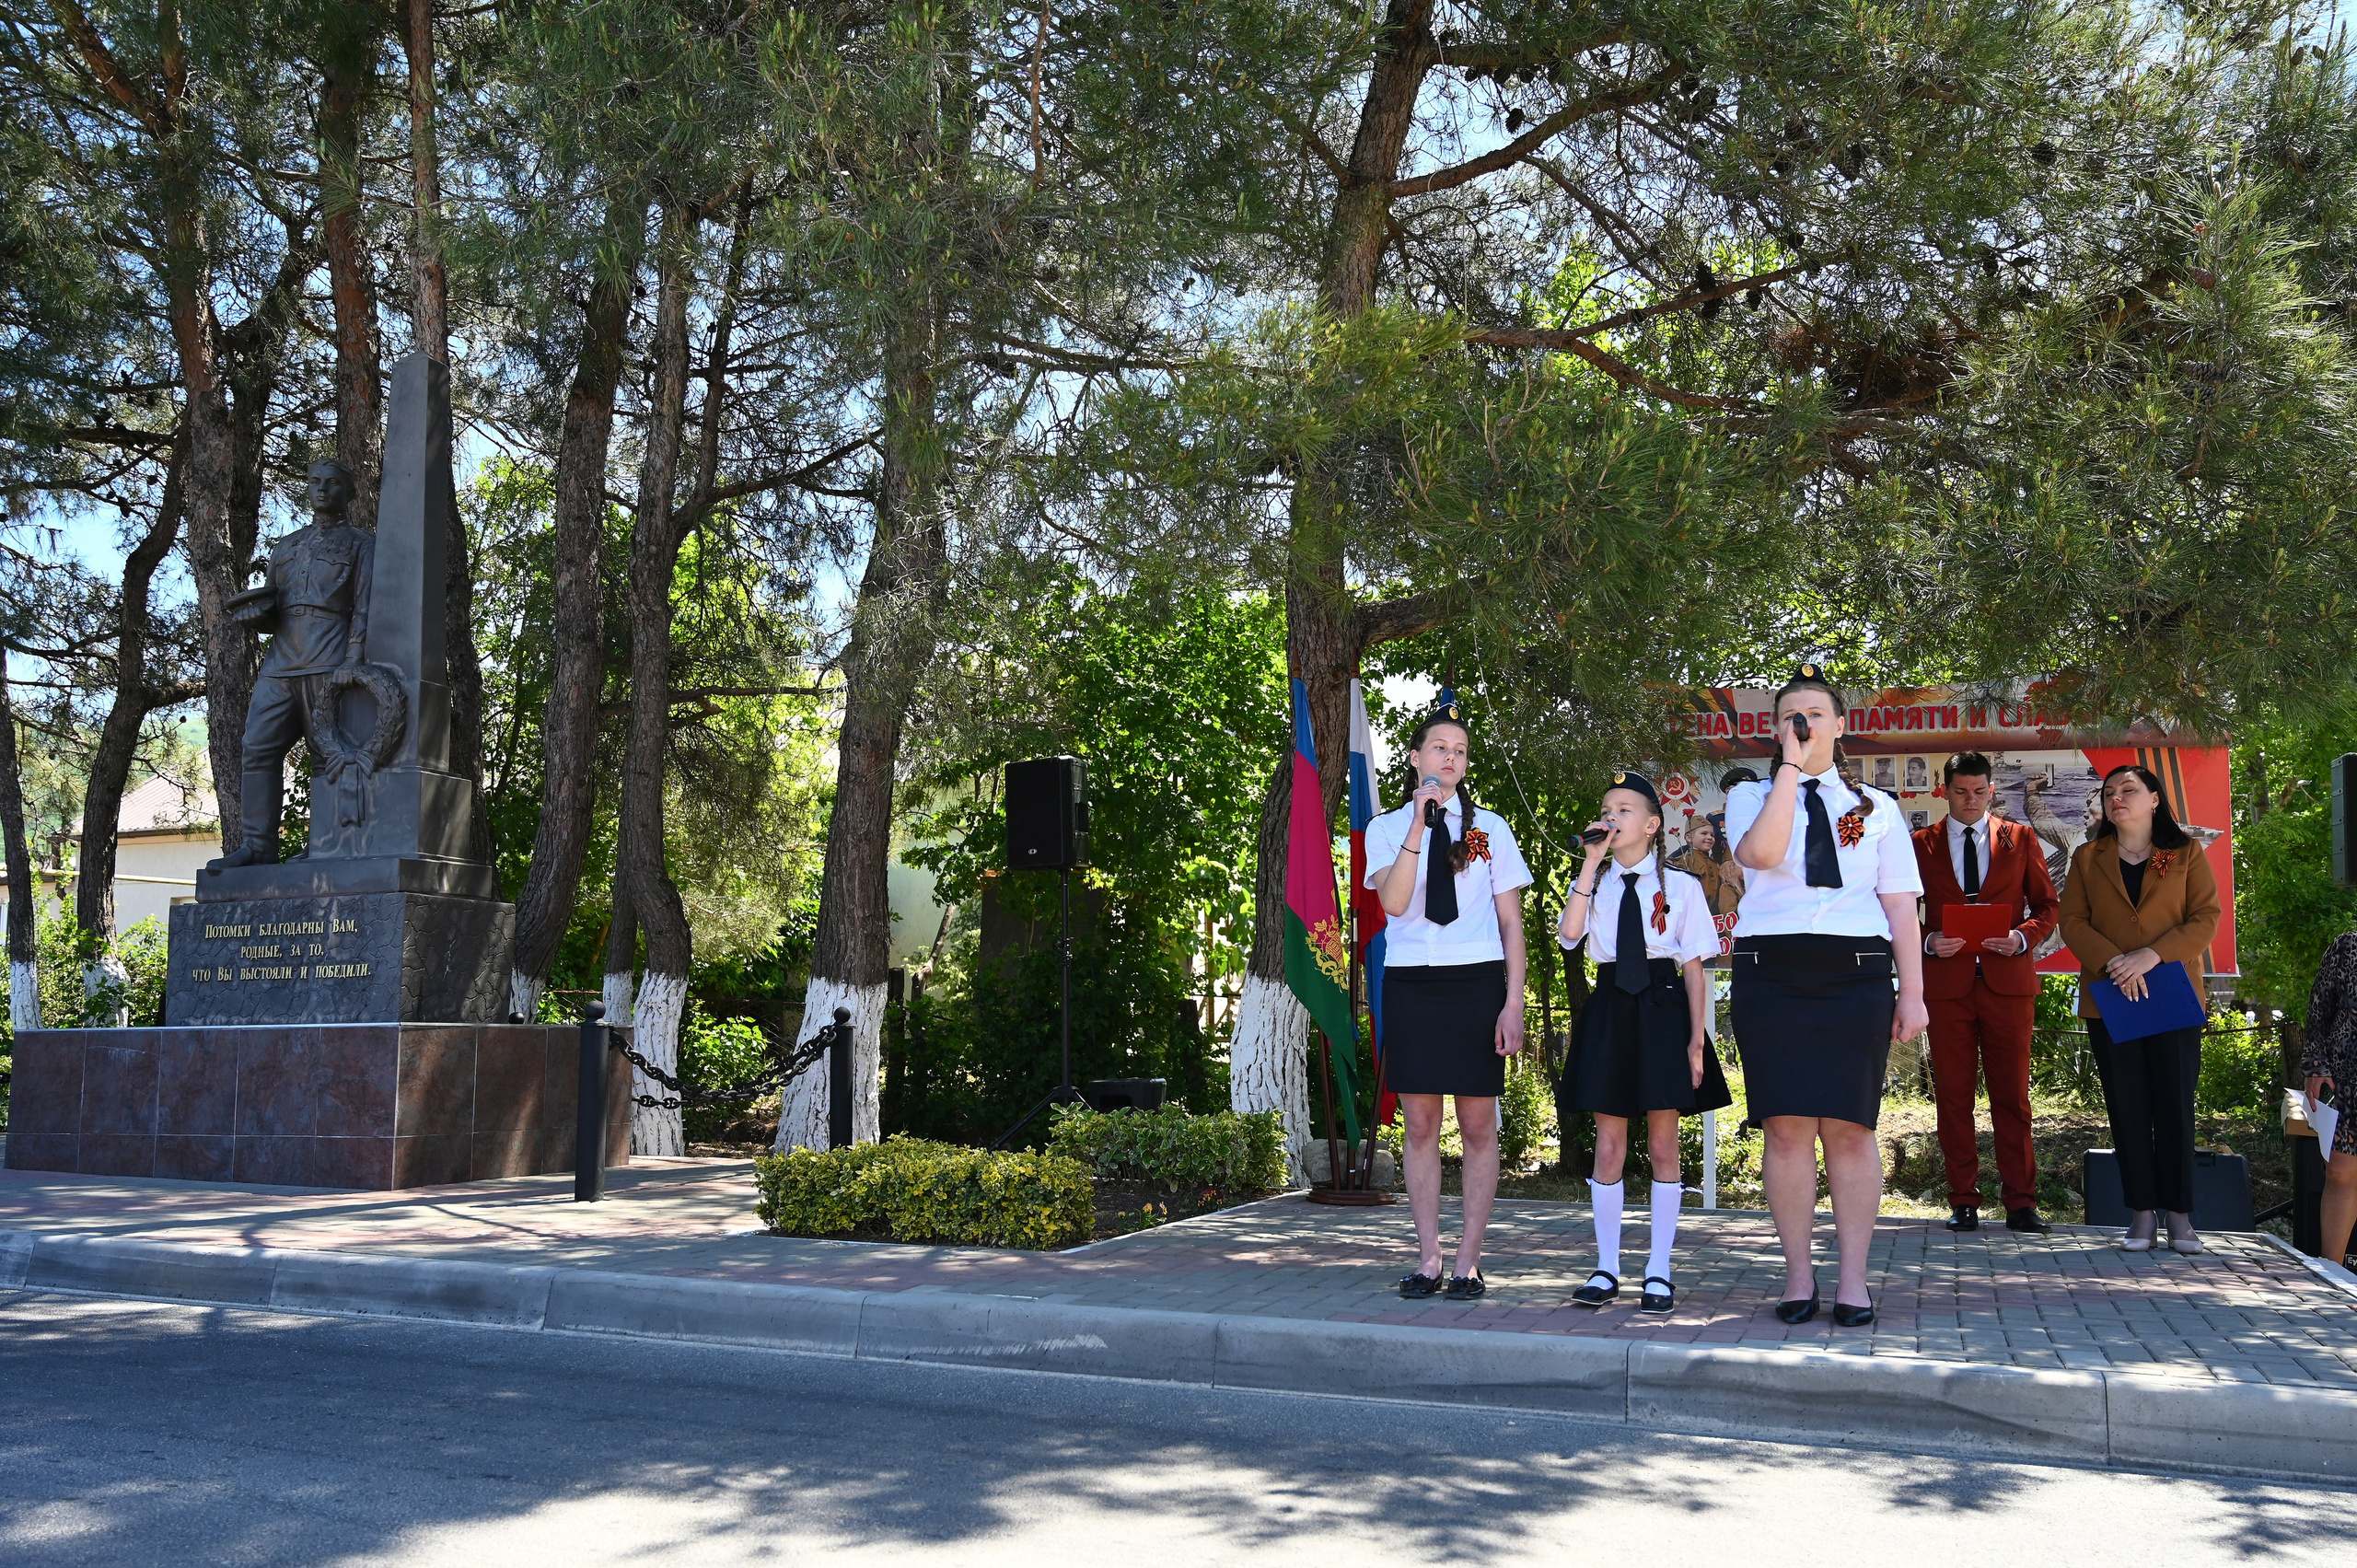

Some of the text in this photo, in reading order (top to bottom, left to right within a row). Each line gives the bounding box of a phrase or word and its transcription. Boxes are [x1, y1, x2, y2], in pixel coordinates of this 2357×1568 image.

[1849, 705, 1958, 732] ПАМЯТИ
[1969, 706, 1987, 728] И
[205, 923, 251, 939] ПОТОМКИ
[259, 921, 325, 936] БЛАГОДАРНЫ
[240, 943, 324, 959] РОДНЫЕ, ЗА ТО,
[192, 969, 212, 982] ЧТО
[239, 965, 293, 981] ВЫСТОЯЛИ
[300, 966, 308, 979] И
[315, 963, 371, 979] ПОБЕДИЛИ.
